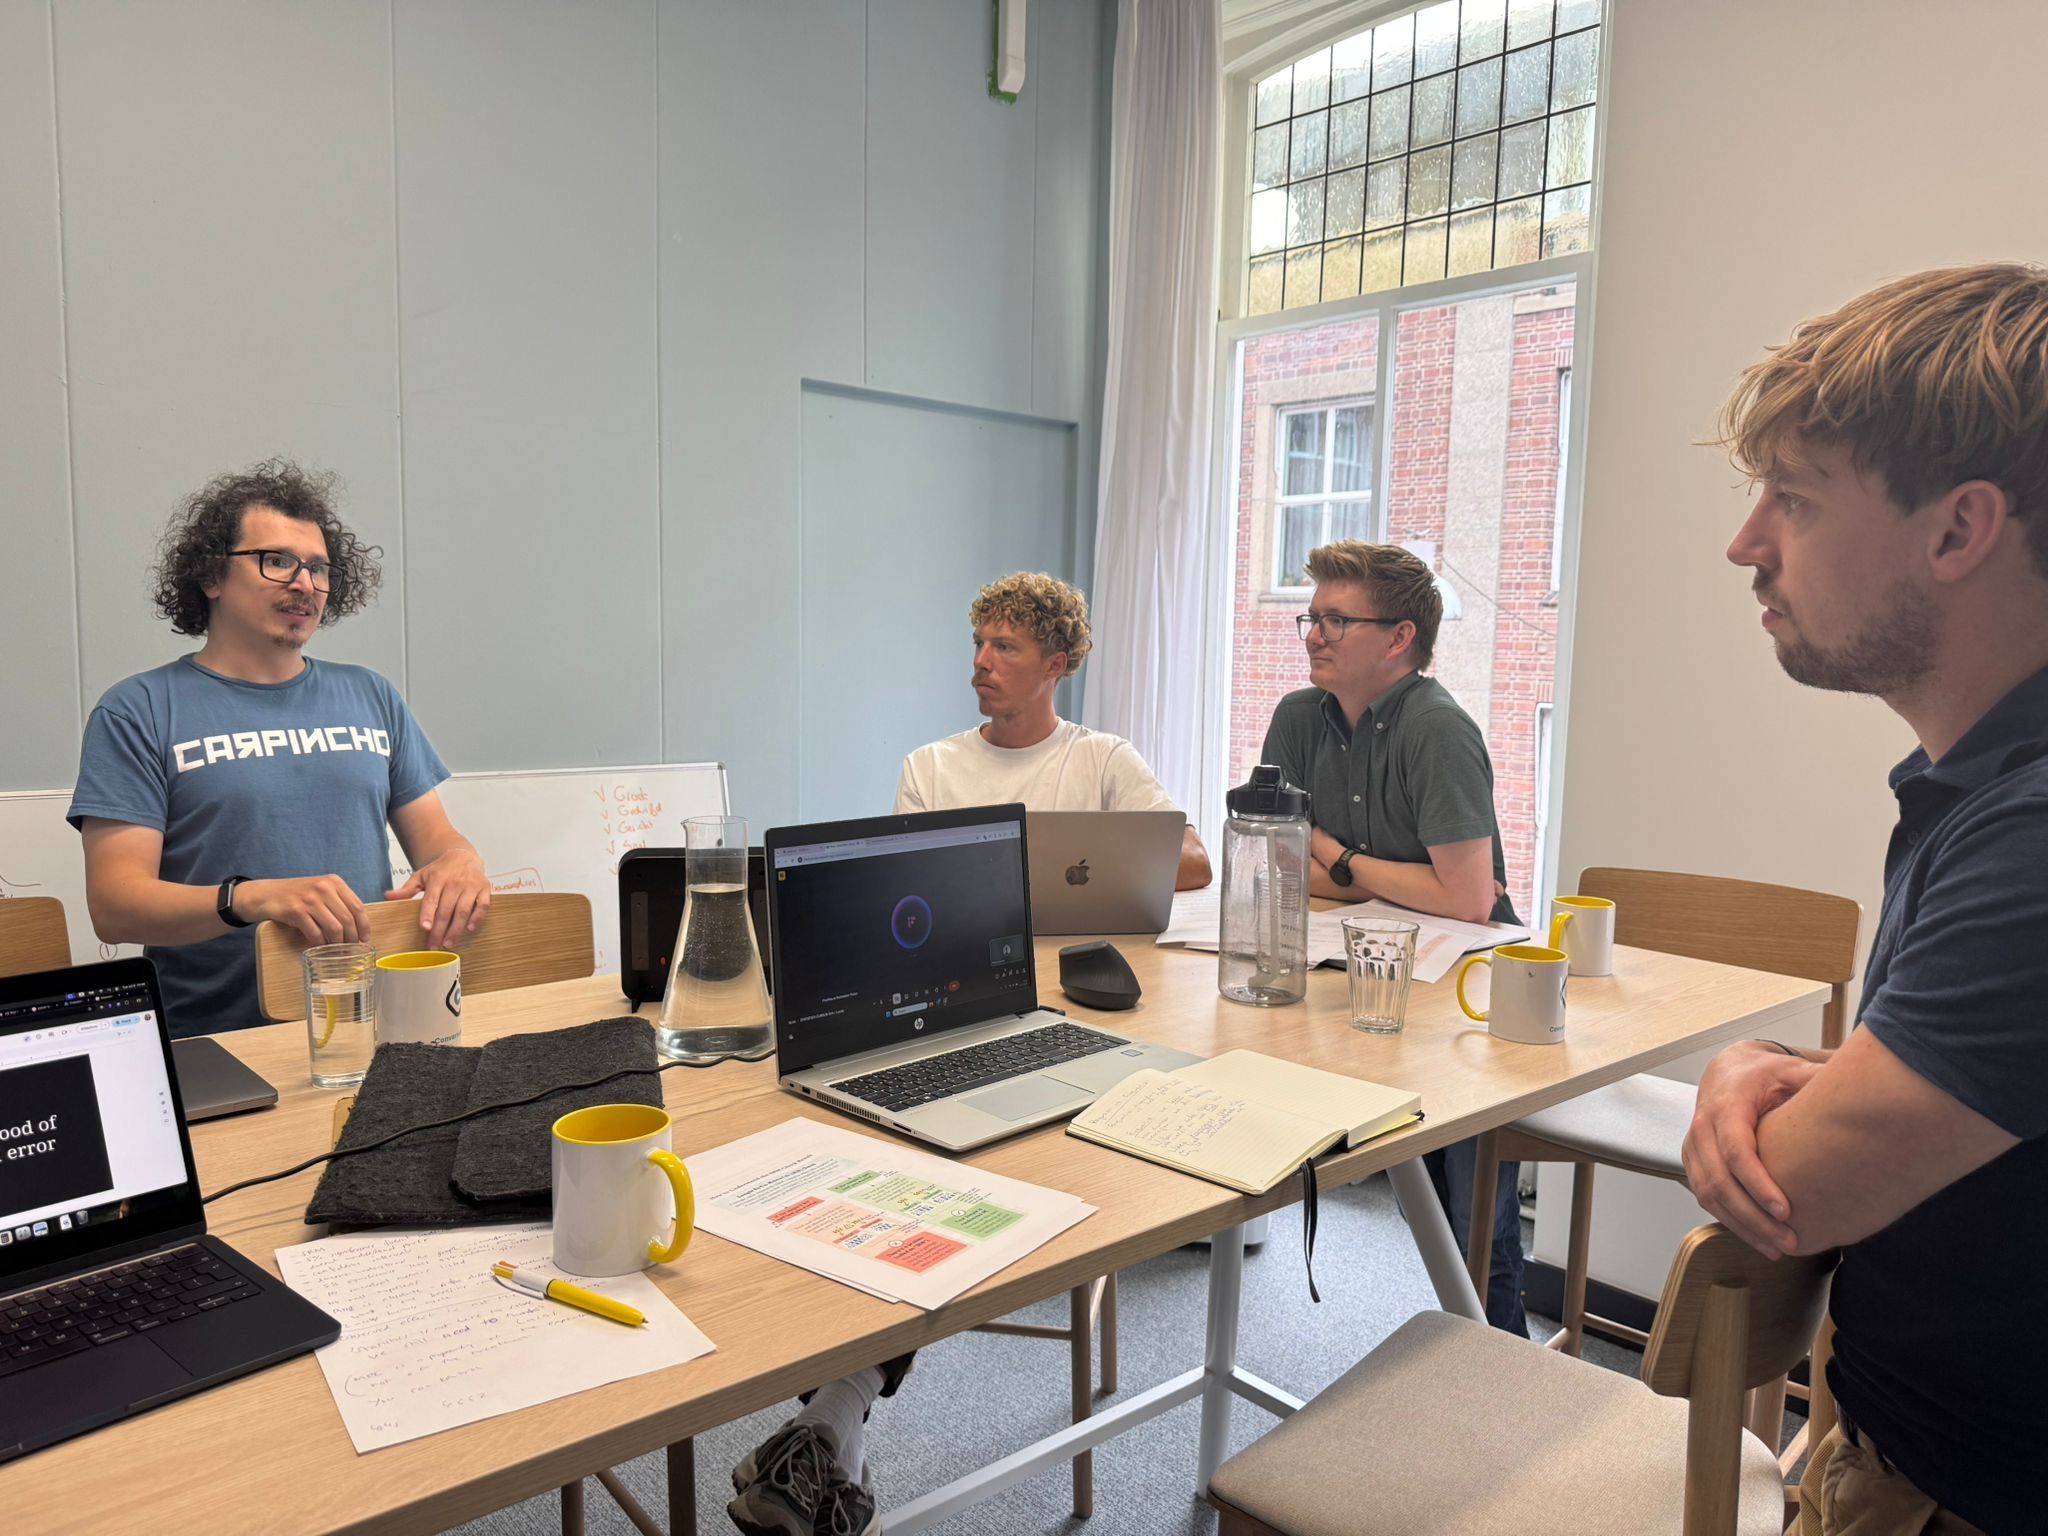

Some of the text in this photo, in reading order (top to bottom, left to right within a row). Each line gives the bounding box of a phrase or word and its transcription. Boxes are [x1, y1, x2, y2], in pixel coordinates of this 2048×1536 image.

[38, 1114, 57, 1131] of
[7, 1139, 56, 1159] error
[442, 1325, 470, 1339] need
